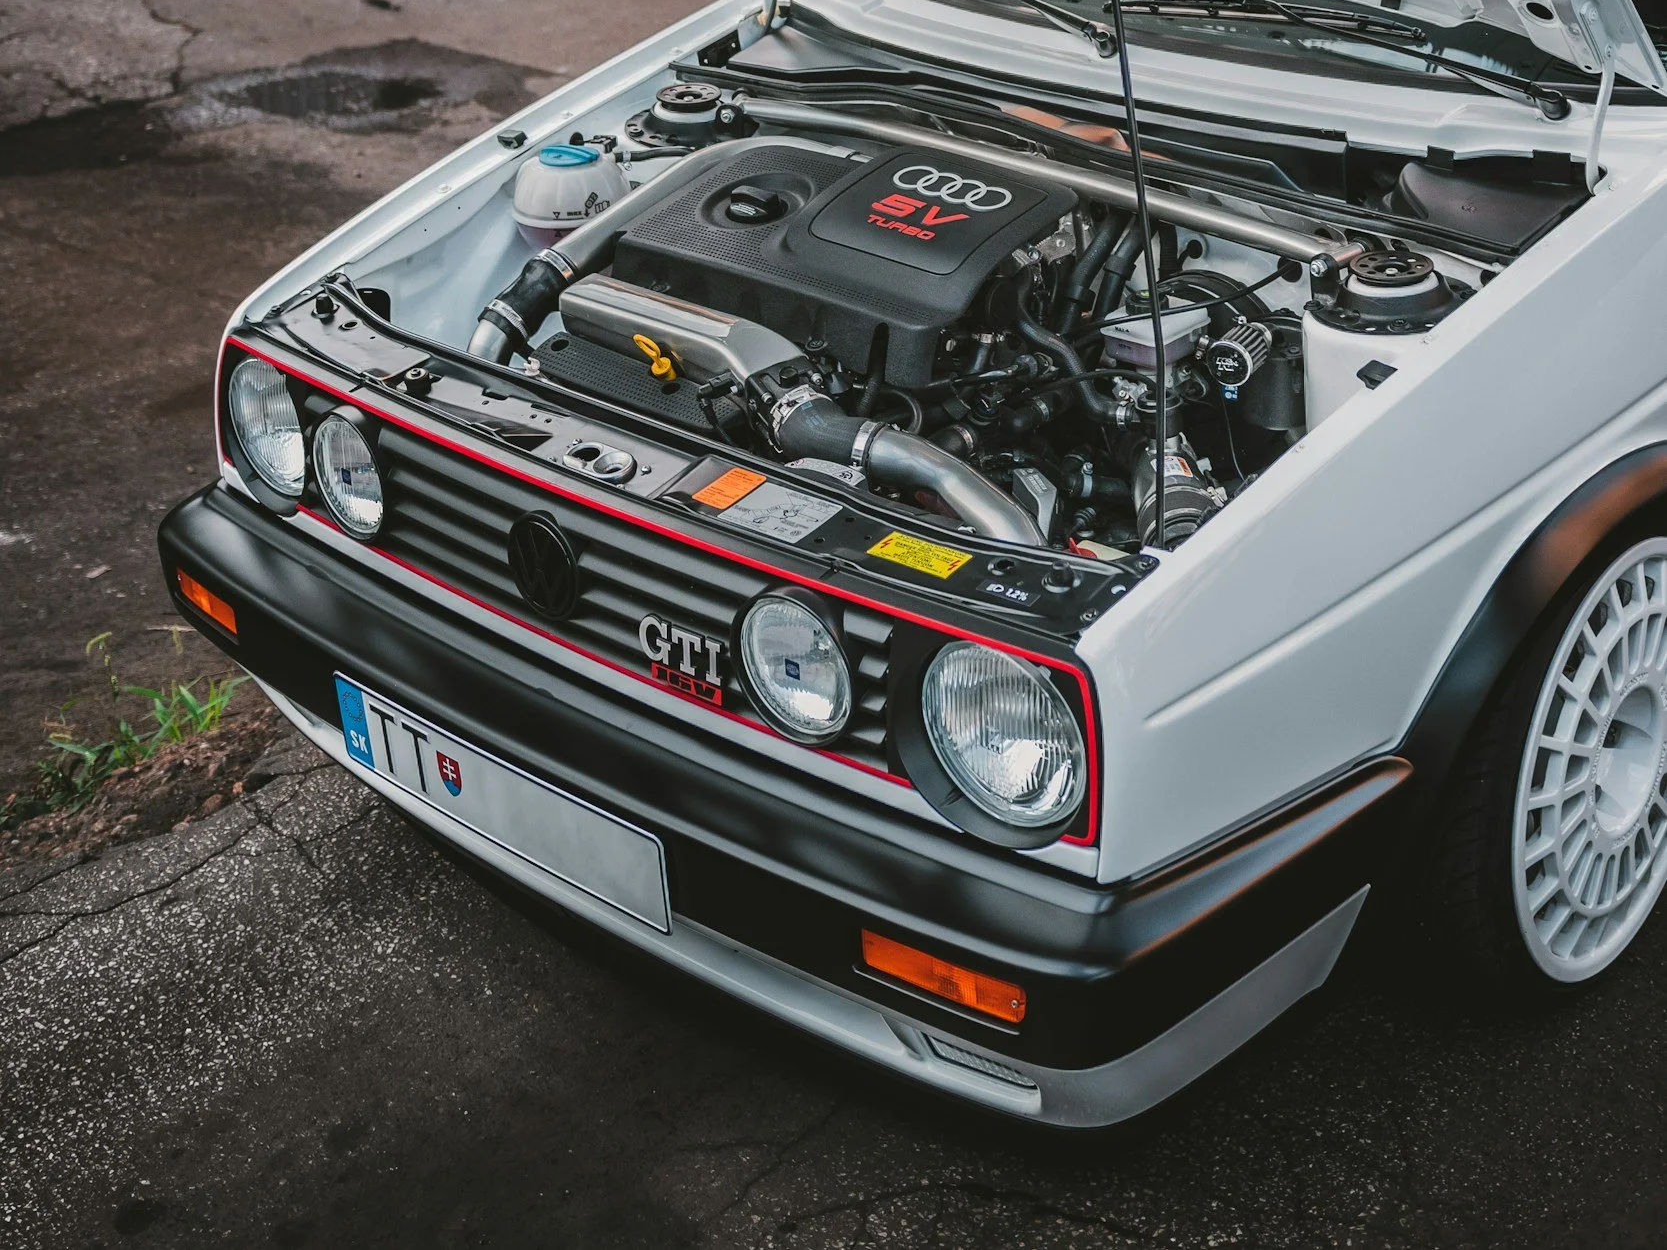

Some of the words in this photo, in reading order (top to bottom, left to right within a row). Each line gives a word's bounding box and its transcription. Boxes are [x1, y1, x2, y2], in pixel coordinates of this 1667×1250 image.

[867, 214, 936, 241] TURBO
[638, 612, 725, 687] GTI
[349, 729, 369, 754] SK
[368, 702, 429, 796] TT
